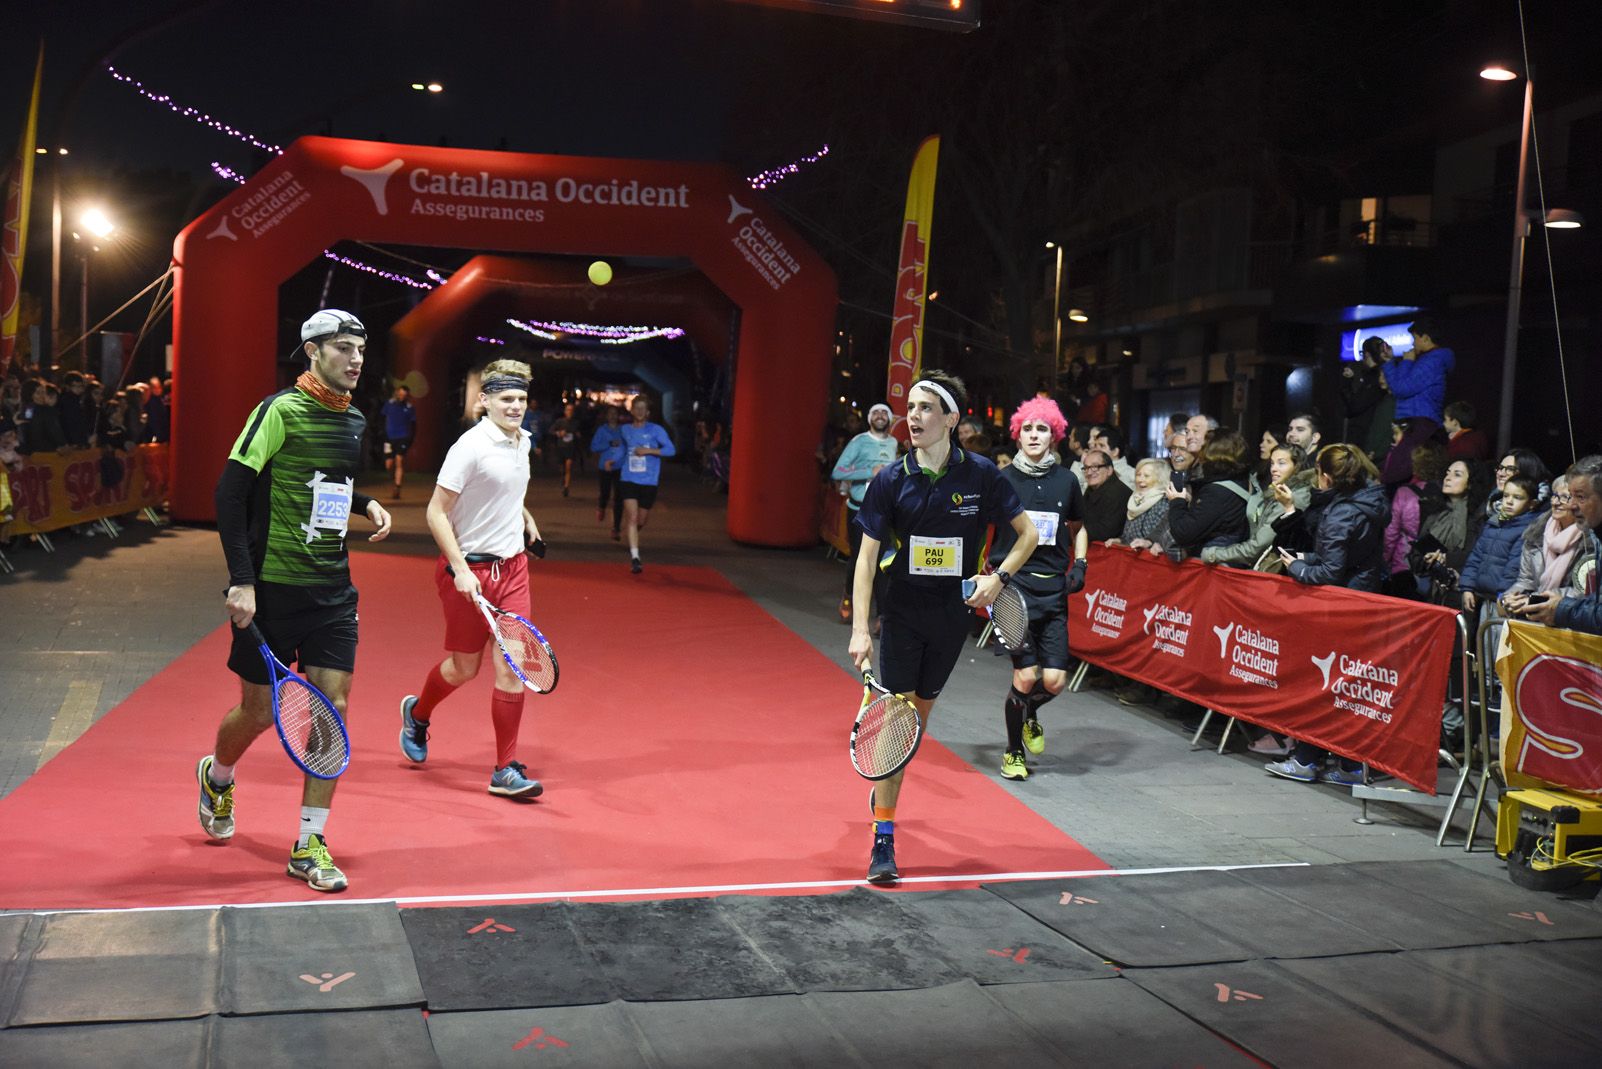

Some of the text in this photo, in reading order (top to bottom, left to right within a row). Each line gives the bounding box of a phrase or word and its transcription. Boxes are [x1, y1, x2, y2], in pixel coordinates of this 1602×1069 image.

[232, 171, 293, 218] Catalana
[409, 168, 690, 208] Catalana Occident
[241, 180, 304, 230] Occident
[411, 198, 544, 222] Assegurances
[740, 226, 791, 284] Occident
[751, 218, 800, 273] Catalana
[318, 500, 348, 518] 2253
[925, 548, 944, 557] PAU
[925, 557, 944, 566] 699
[1098, 590, 1127, 612] Catalana
[1094, 606, 1124, 629] Occident
[1235, 624, 1279, 655] Catalana
[1229, 664, 1278, 689] Assegurances
[1232, 645, 1278, 677] Occident
[1331, 677, 1394, 709] Occident
